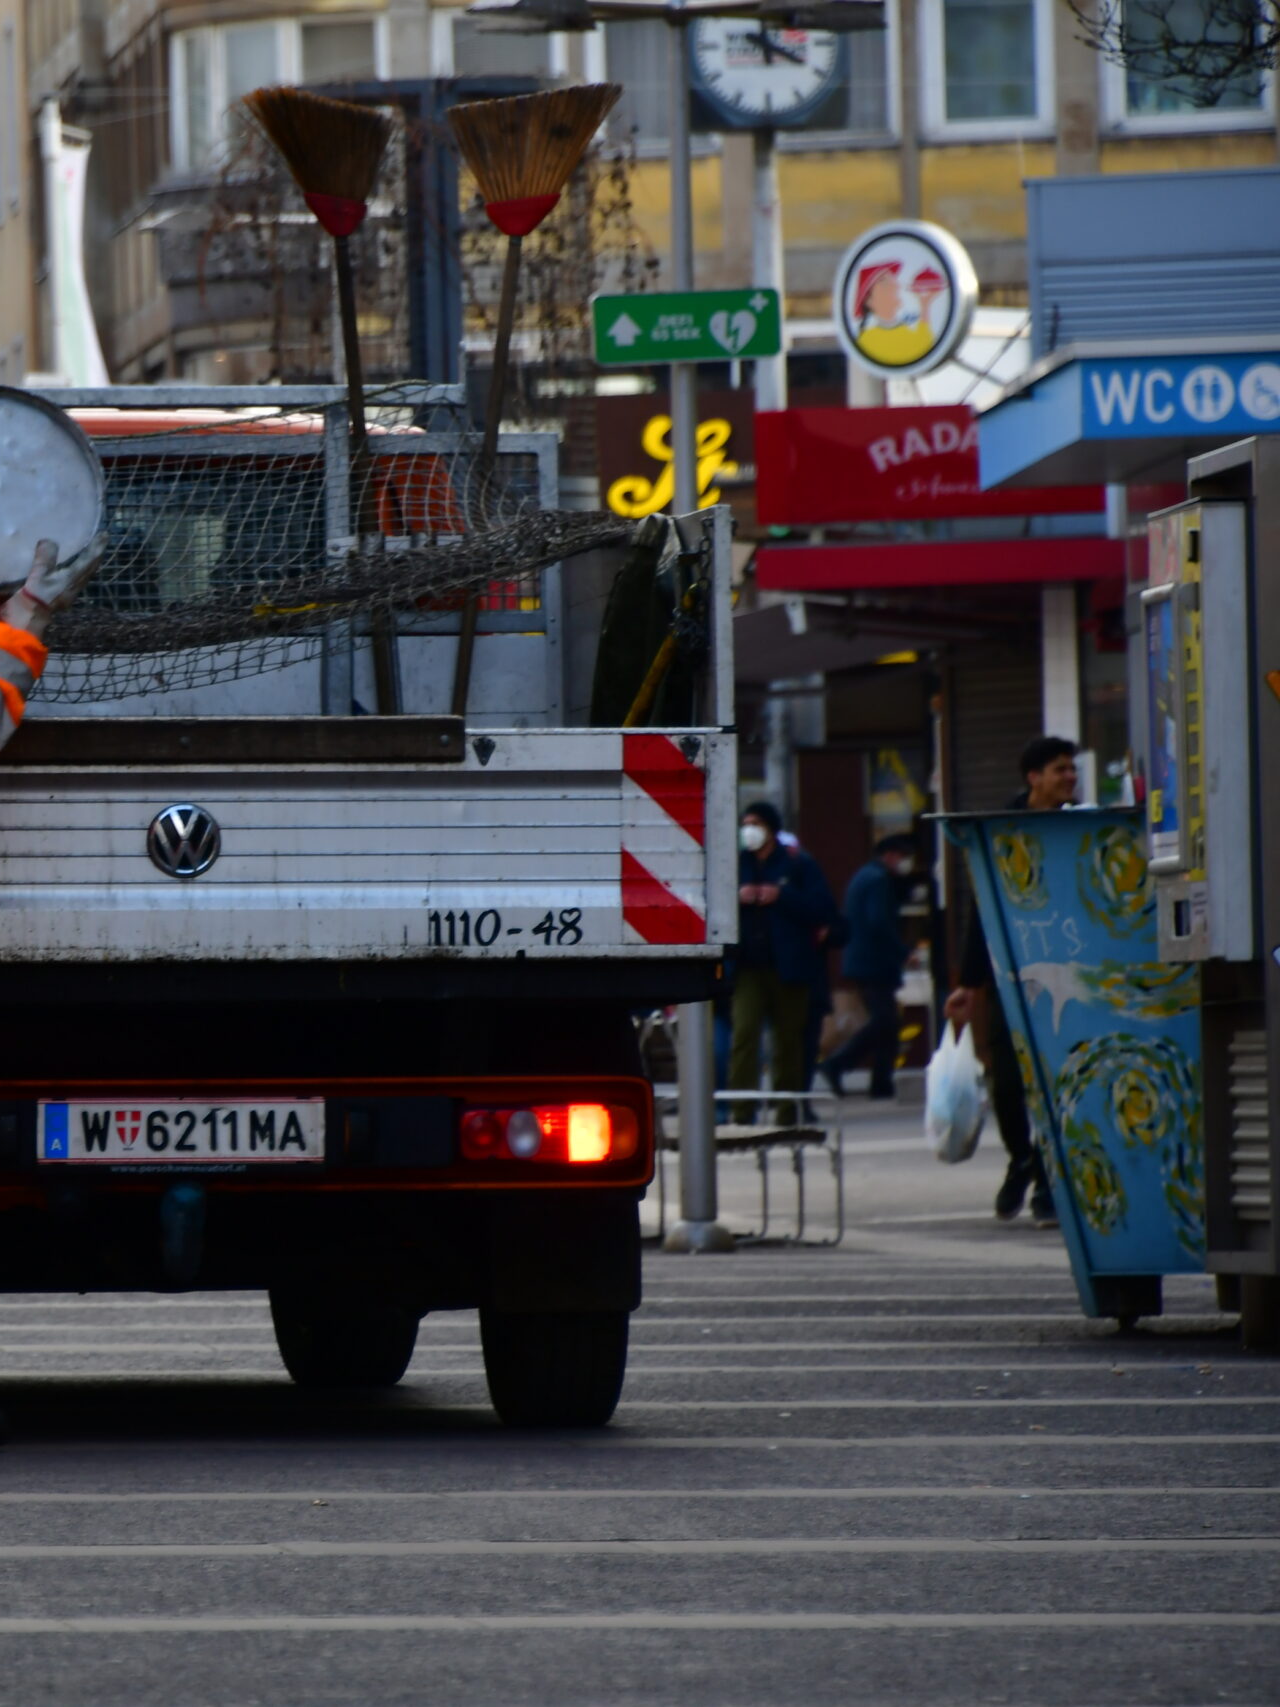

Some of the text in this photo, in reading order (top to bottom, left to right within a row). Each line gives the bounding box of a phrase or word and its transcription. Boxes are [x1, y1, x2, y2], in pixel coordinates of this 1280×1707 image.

[1091, 369, 1174, 425] WC
[149, 805, 219, 877] VW
[429, 907, 584, 947] 1110-48
[51, 1138, 63, 1151] A
[81, 1110, 111, 1152] W
